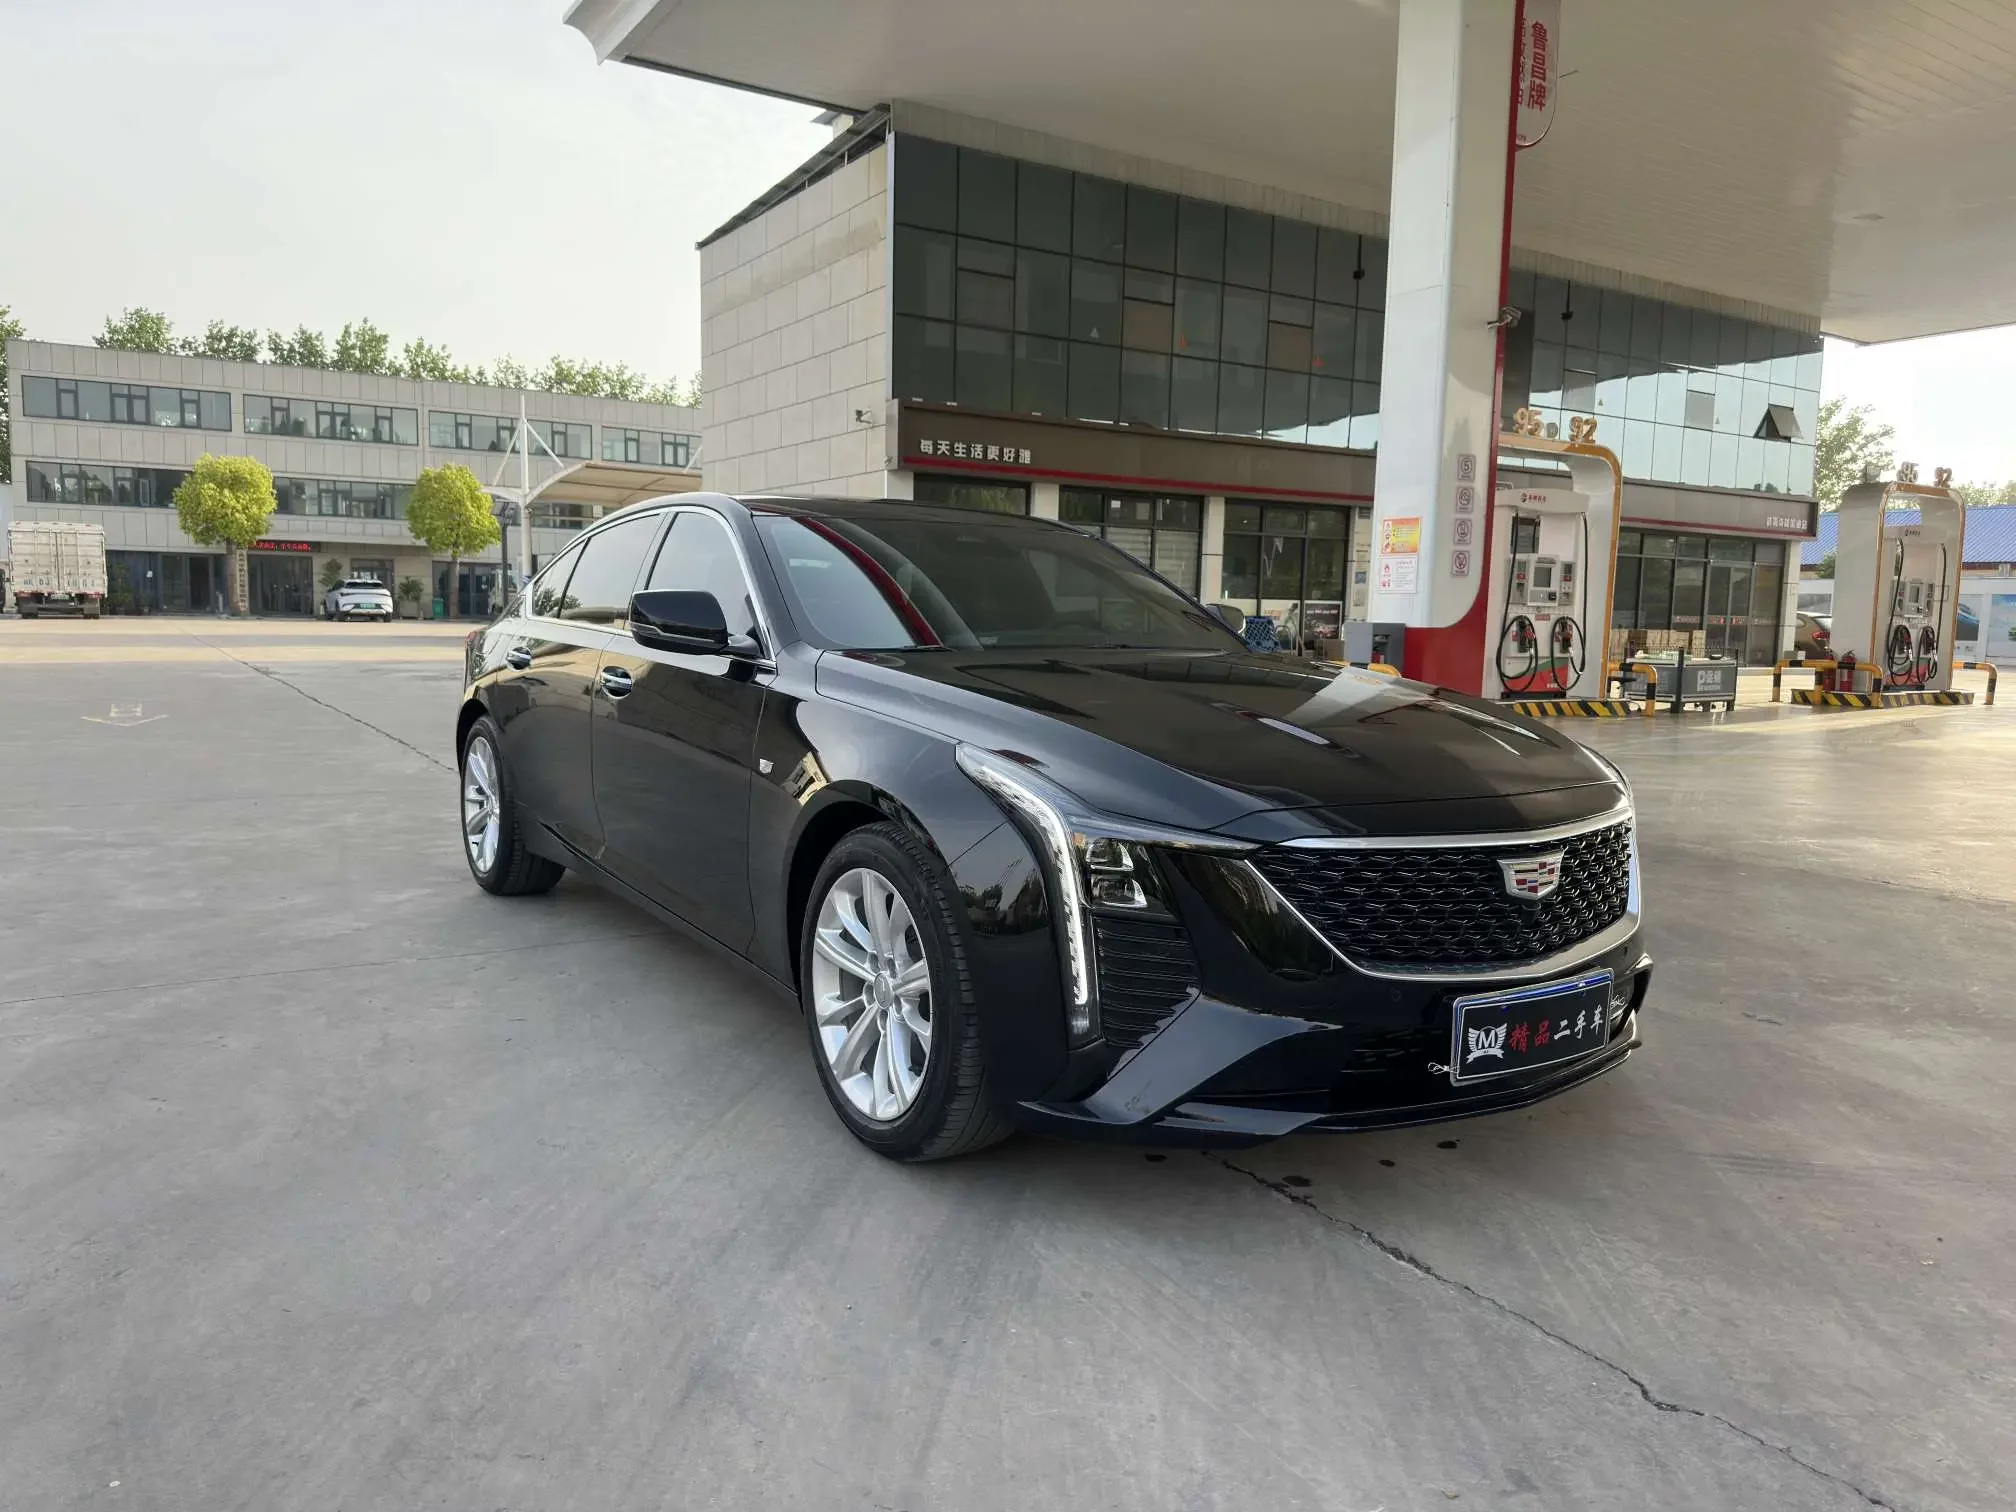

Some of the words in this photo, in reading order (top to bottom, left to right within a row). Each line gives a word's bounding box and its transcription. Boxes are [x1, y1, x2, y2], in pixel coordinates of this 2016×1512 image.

[1513, 407, 1544, 436] 95
[1568, 416, 1598, 444] 92
[1509, 1004, 1604, 1053] 精品二手车
